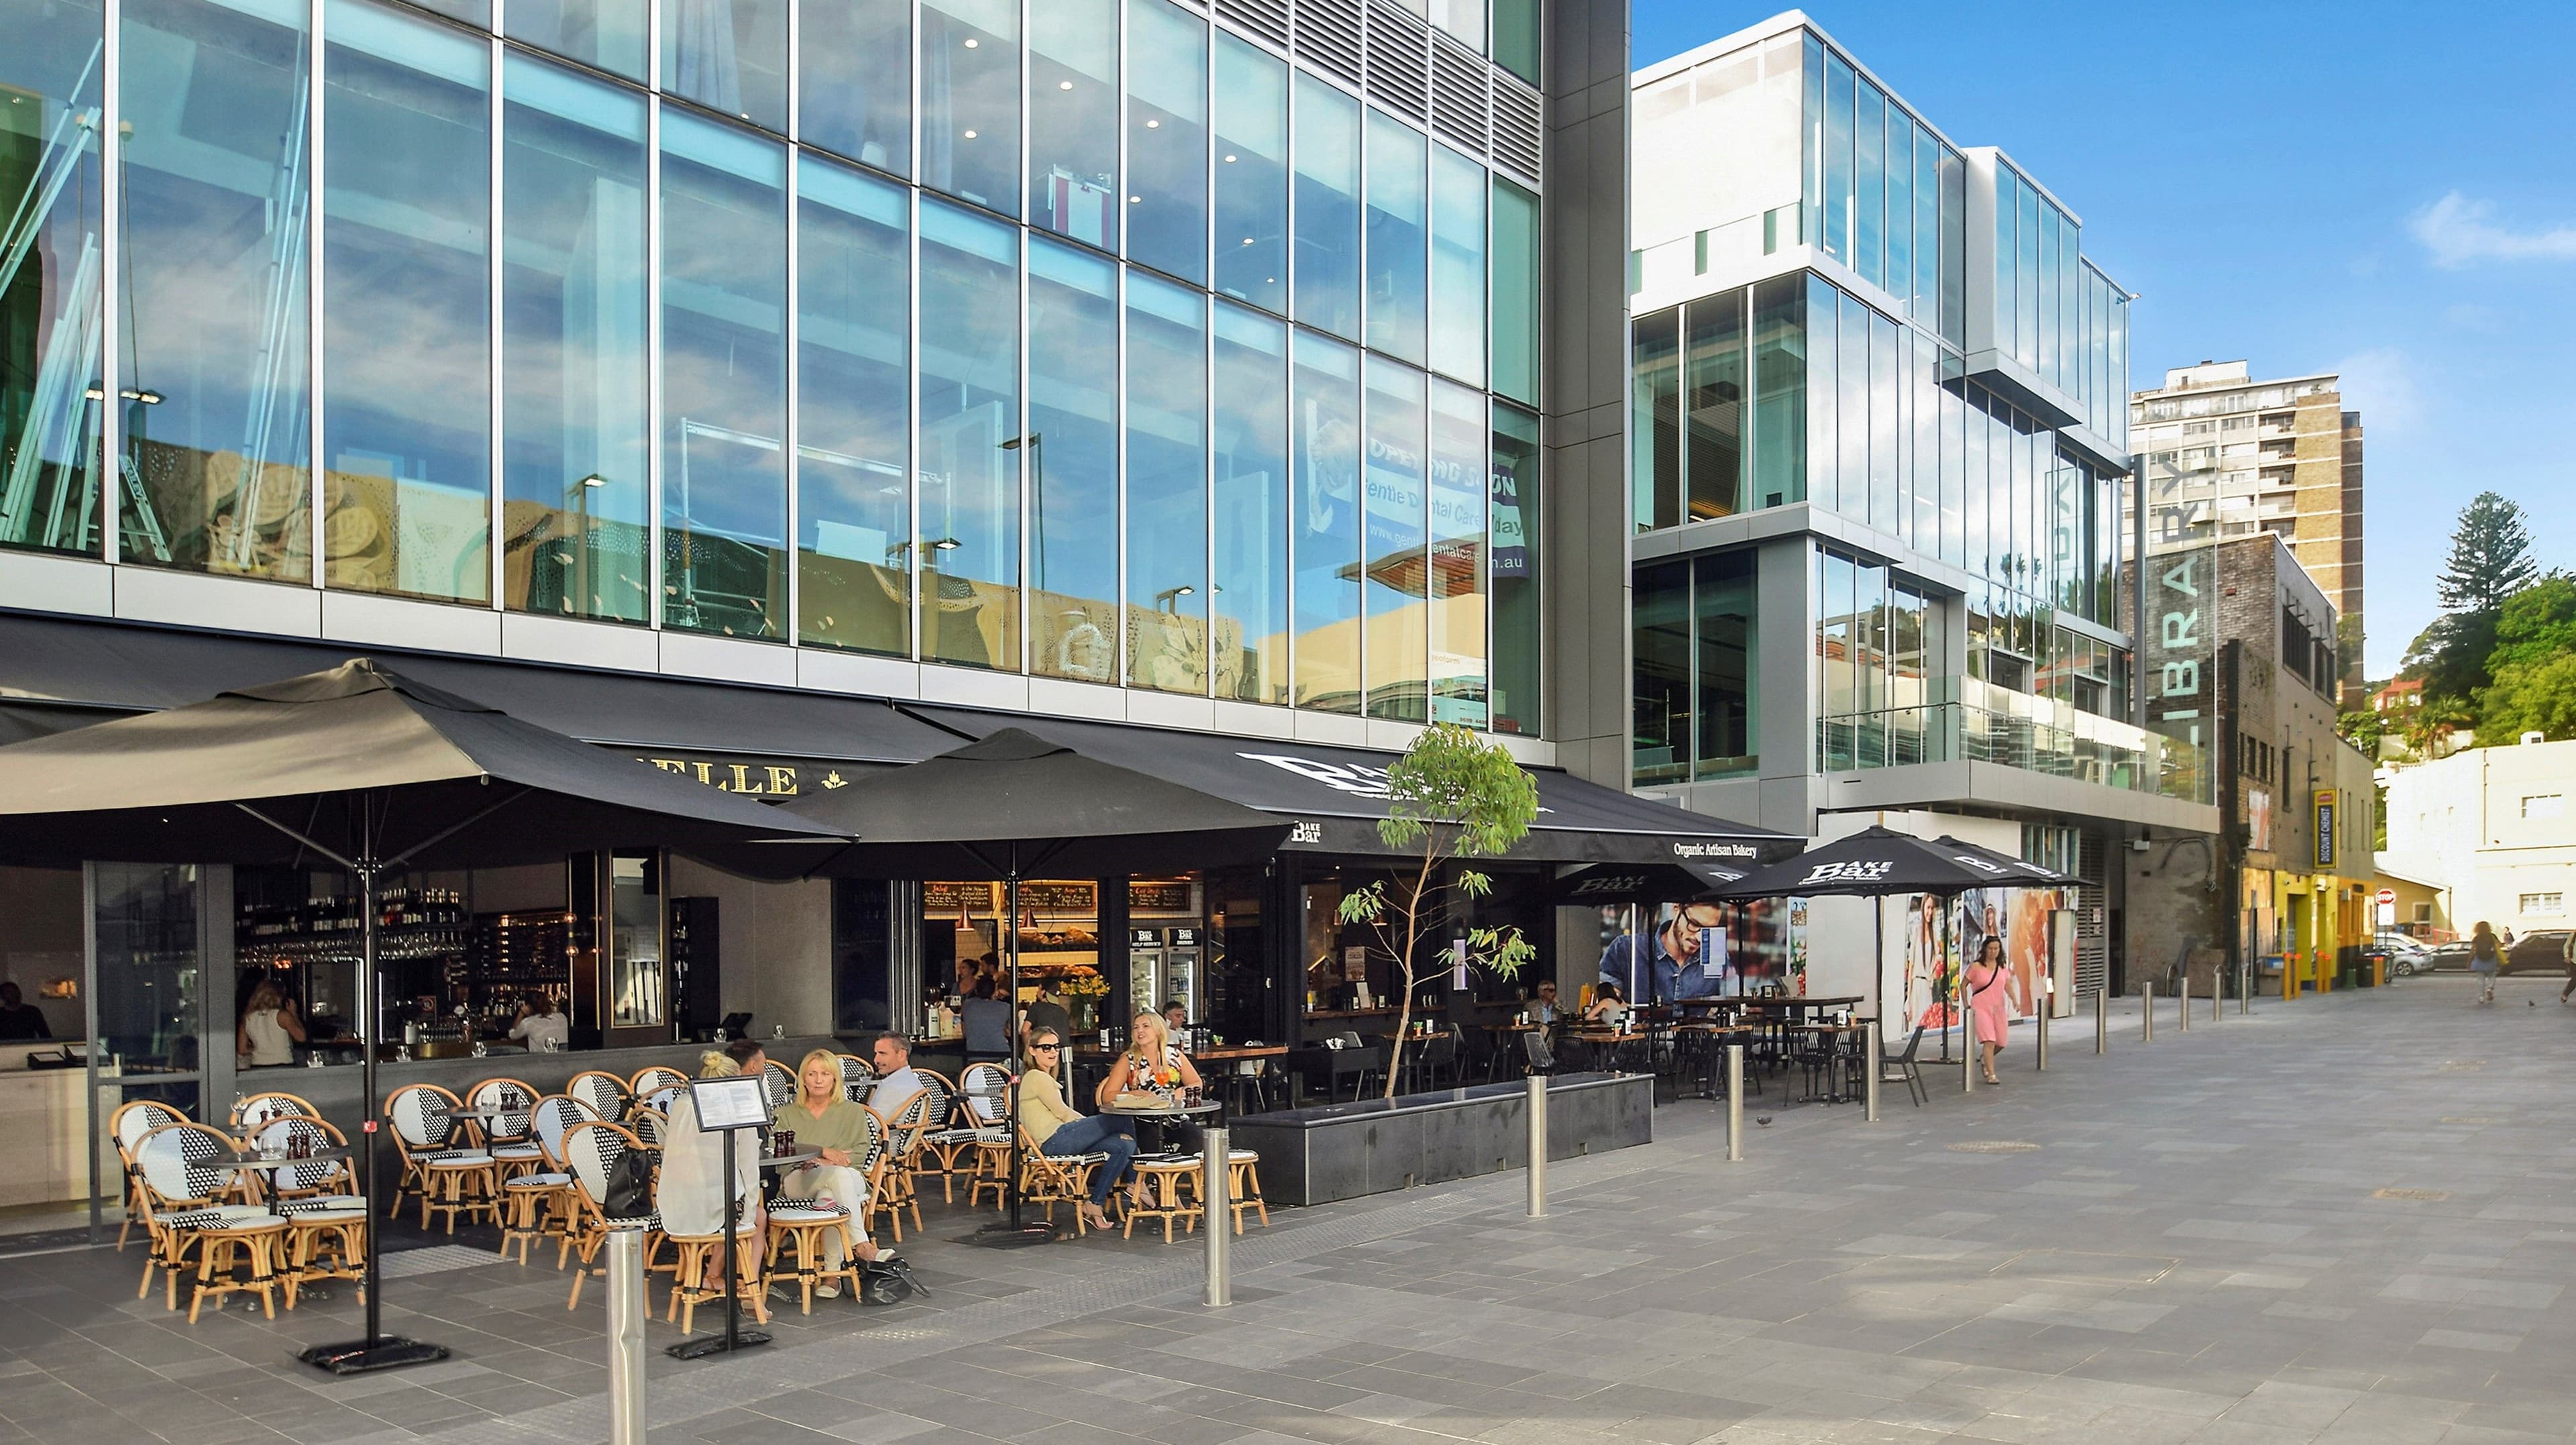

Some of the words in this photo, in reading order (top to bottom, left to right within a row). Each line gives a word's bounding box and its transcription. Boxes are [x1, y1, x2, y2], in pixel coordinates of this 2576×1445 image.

[1366, 476, 1405, 504] entle
[1674, 843, 1705, 858] Organic
[1705, 843, 1732, 855] Artisan
[1732, 845, 1757, 859] Bakery
